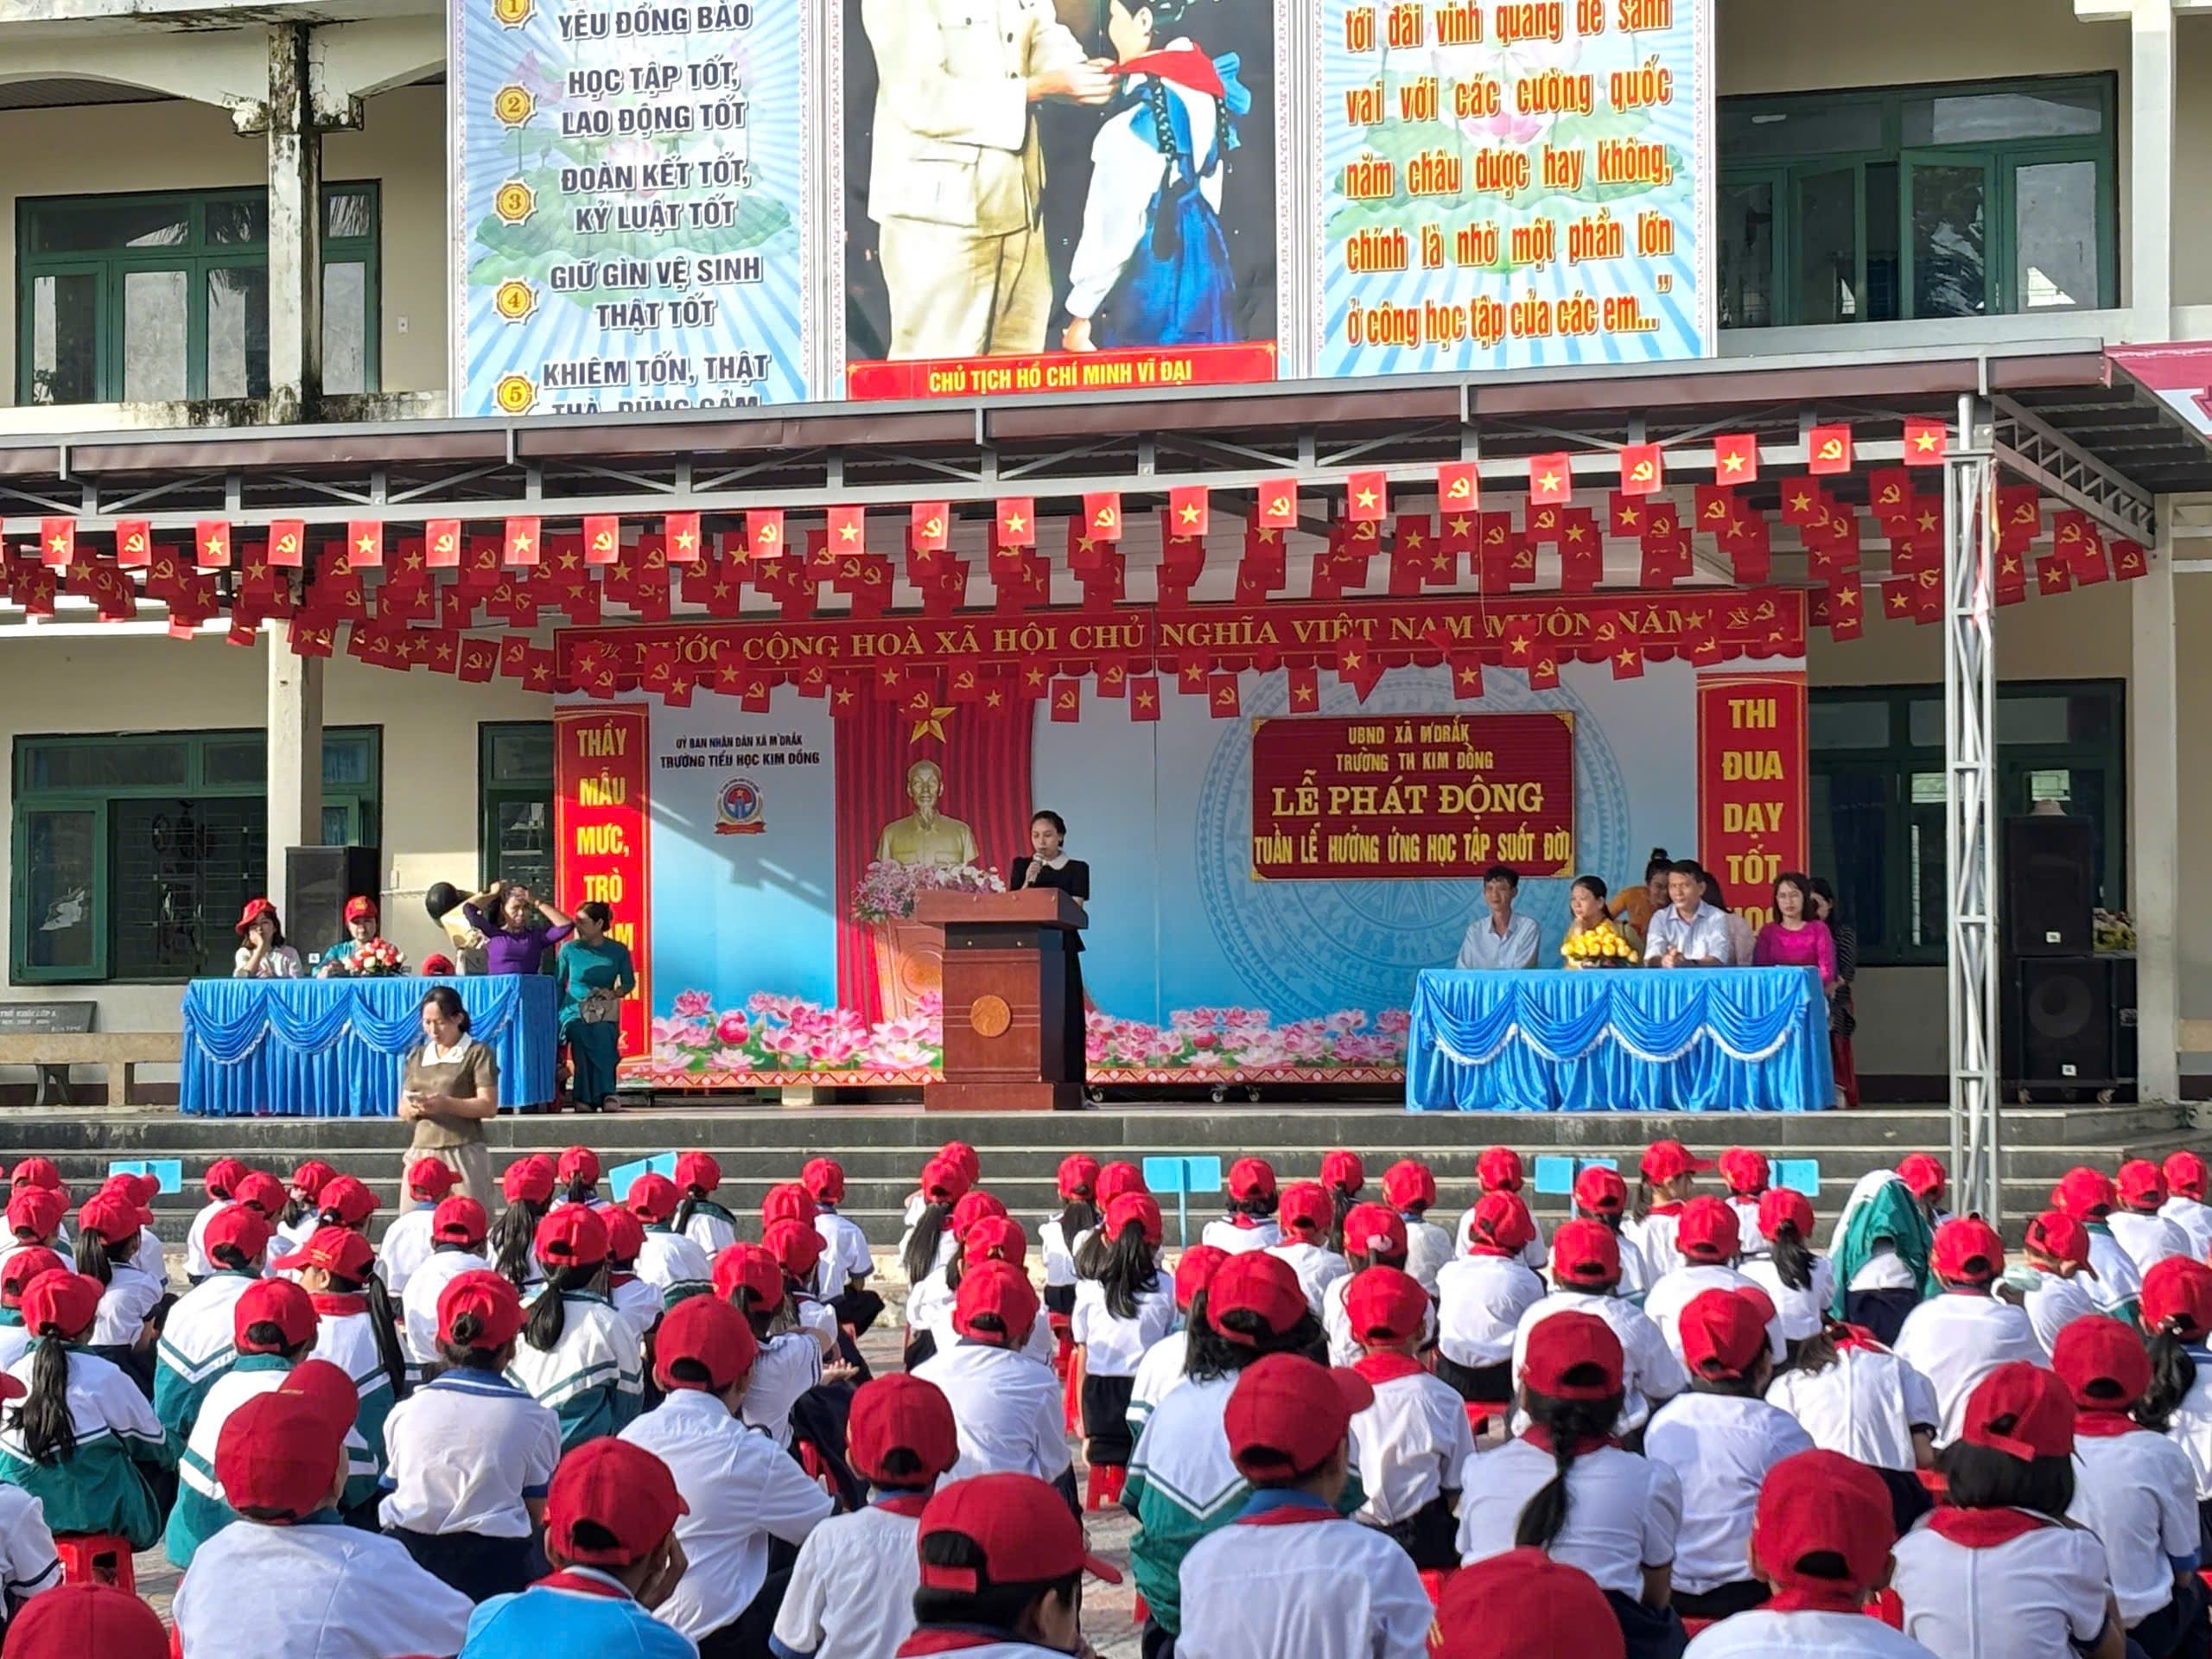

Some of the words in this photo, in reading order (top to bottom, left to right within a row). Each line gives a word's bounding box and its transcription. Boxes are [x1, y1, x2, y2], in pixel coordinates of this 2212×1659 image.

[558, 9, 607, 37] YÊU
[615, 2, 687, 34] ĐỒNG
[697, 0, 749, 29] BÀO
[1346, 8, 1375, 50] tới
[1389, 4, 1422, 47] đài
[1496, 2, 1560, 43] quang
[569, 70, 621, 99] HỌC
[630, 63, 679, 94] TẬP
[690, 54, 739, 87] TỐT,
[1346, 81, 1382, 124] vai
[1401, 73, 1438, 119] với
[1455, 73, 1499, 115] các
[1516, 67, 1593, 114] cường
[1611, 55, 1671, 110] quốc
[508, 96, 520, 113] 2
[563, 110, 611, 135] LAO
[618, 103, 691, 138] ĐỘNG
[700, 94, 746, 127] TỐT
[562, 162, 635, 192] ĐOÀN
[643, 154, 690, 187] KẾT
[697, 150, 750, 186] TỐT,
[1346, 154, 1393, 198] năm
[1408, 149, 1460, 194] châu
[1476, 147, 1529, 197] được
[1544, 144, 1582, 189] hay
[1598, 137, 1672, 184] không,
[508, 194, 520, 210] 3
[576, 201, 611, 231] KỶ
[618, 200, 682, 234] LUẬT
[690, 193, 734, 224] TỐT
[1347, 229, 1408, 272] chính
[1421, 226, 1443, 268] là
[1457, 222, 1499, 266] nhờ
[1511, 221, 1555, 270] một
[1569, 208, 1623, 263] phần
[1638, 212, 1671, 255] lớn
[550, 259, 599, 288] GIỮ
[605, 259, 647, 286] GÌN
[657, 256, 688, 290] VỆ
[697, 257, 760, 283] SINH
[508, 293, 520, 308] 4
[596, 302, 662, 334] THẬT
[668, 293, 715, 325] TỐT
[1348, 298, 1362, 345] ở
[1366, 302, 1419, 346] công
[1425, 299, 1465, 351] học
[1471, 296, 1502, 347] tập
[1510, 289, 1550, 336] của
[1556, 290, 1597, 334] các
[543, 357, 626, 387] KHIÊM
[635, 352, 696, 385] TỐN,
[703, 352, 770, 385] THẬT
[929, 364, 965, 392] CHỦ
[970, 366, 1011, 395] TỊCH
[1016, 359, 1042, 389] HỒ
[1046, 361, 1077, 386] CHÍ
[1084, 361, 1132, 385] MINH
[1137, 359, 1155, 382] VĨ
[1160, 360, 1192, 385] ĐẠI
[509, 386, 522, 401] 5
[743, 631, 838, 665] CỘNG
[850, 625, 925, 658] HOÀ
[935, 624, 981, 655] XÃ
[992, 623, 1058, 656] HỘI
[1069, 615, 1145, 650] CHỦ
[1160, 615, 1280, 647] NGHĨA
[1291, 612, 1380, 644] VIỆT
[1389, 615, 1473, 642] NAM
[1728, 698, 1777, 728] THI
[576, 718, 627, 757] THẦY
[690, 737, 707, 748] BAN
[1348, 726, 1385, 745] UBND
[1394, 720, 1413, 744] XÃ
[736, 753, 760, 769] HỌC
[763, 753, 785, 766] KIM
[1335, 747, 1389, 772] TRƯỜNG
[1398, 752, 1415, 771] TH
[1422, 752, 1449, 770] KIM
[1457, 742, 1494, 770] ĐỒNG
[1721, 750, 1784, 780] ĐUA
[579, 766, 626, 806] MẪU
[1271, 769, 1320, 816] LỄ
[1327, 775, 1427, 815] PHÁT
[1438, 774, 1544, 820] ĐỘNG
[1723, 802, 1784, 839] DẠY
[1254, 823, 1293, 864] TUẦN
[1328, 824, 1380, 863] HƯỞNG
[1388, 826, 1421, 863] ỨNG
[1427, 834, 1457, 867] HỌC
[1463, 826, 1491, 865] TẬP
[1497, 821, 1535, 861] SUỐT
[1543, 824, 1571, 861] ĐỜI
[1726, 843, 1782, 884] TỐT
[583, 867, 623, 904] TRÒ
